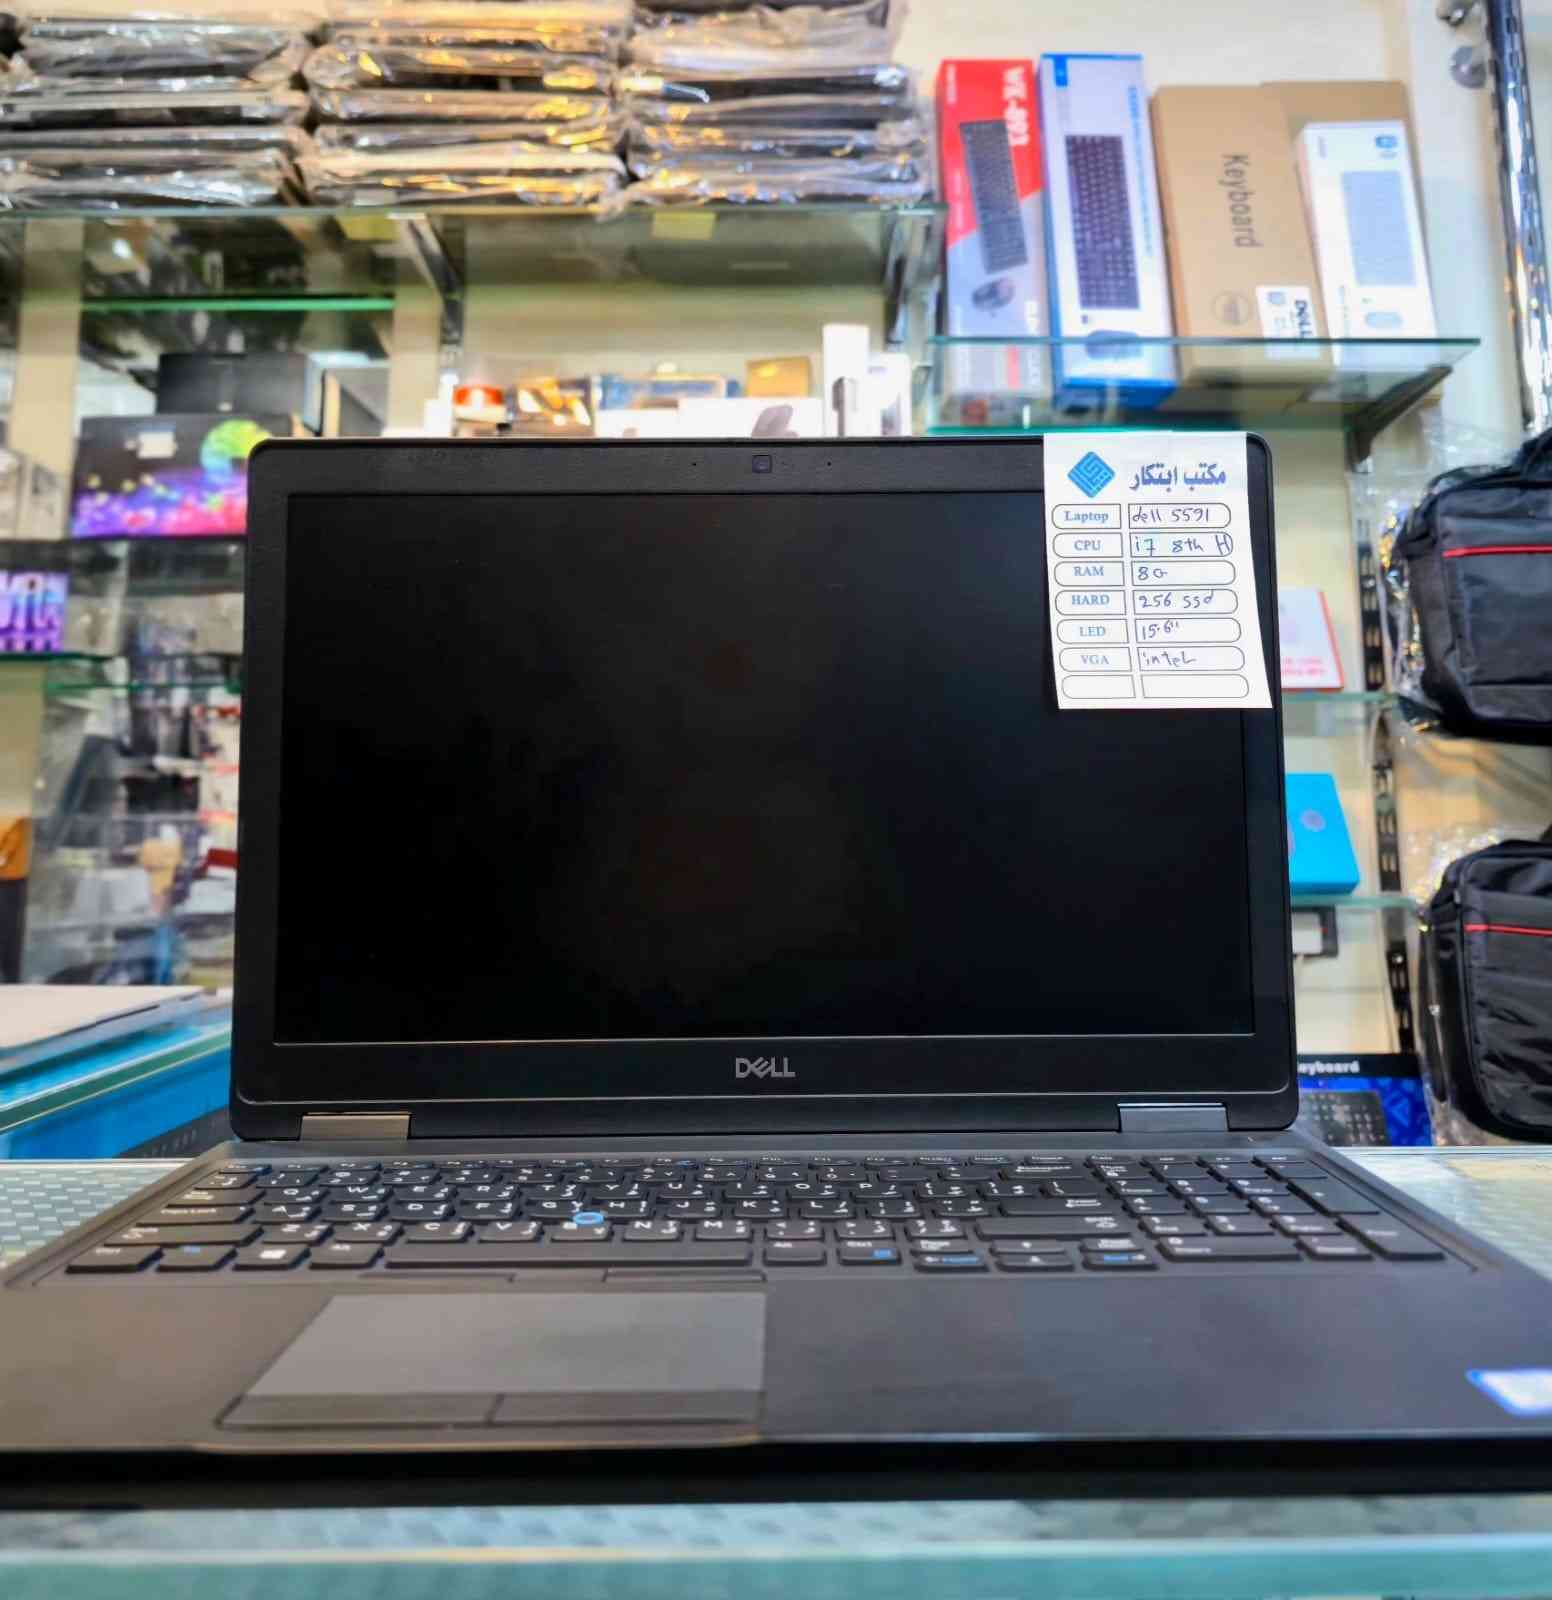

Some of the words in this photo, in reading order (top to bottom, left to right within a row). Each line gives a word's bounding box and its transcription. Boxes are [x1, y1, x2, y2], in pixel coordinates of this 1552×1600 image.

[1218, 152, 1264, 248] Keyboard
[1129, 463, 1178, 492] ابتکار
[1183, 463, 1227, 491] مکتب
[1065, 511, 1109, 523] Laptop
[1074, 539, 1101, 550] CPU
[1172, 537, 1205, 553] 8th
[1074, 566, 1105, 576] RAM
[1071, 594, 1110, 606] HARD
[1139, 591, 1172, 608] 256
[1079, 625, 1106, 636] LED
[1080, 654, 1109, 664] VGA
[736, 1056, 796, 1078] DELL
[1297, 1060, 1360, 1076] eyboard
